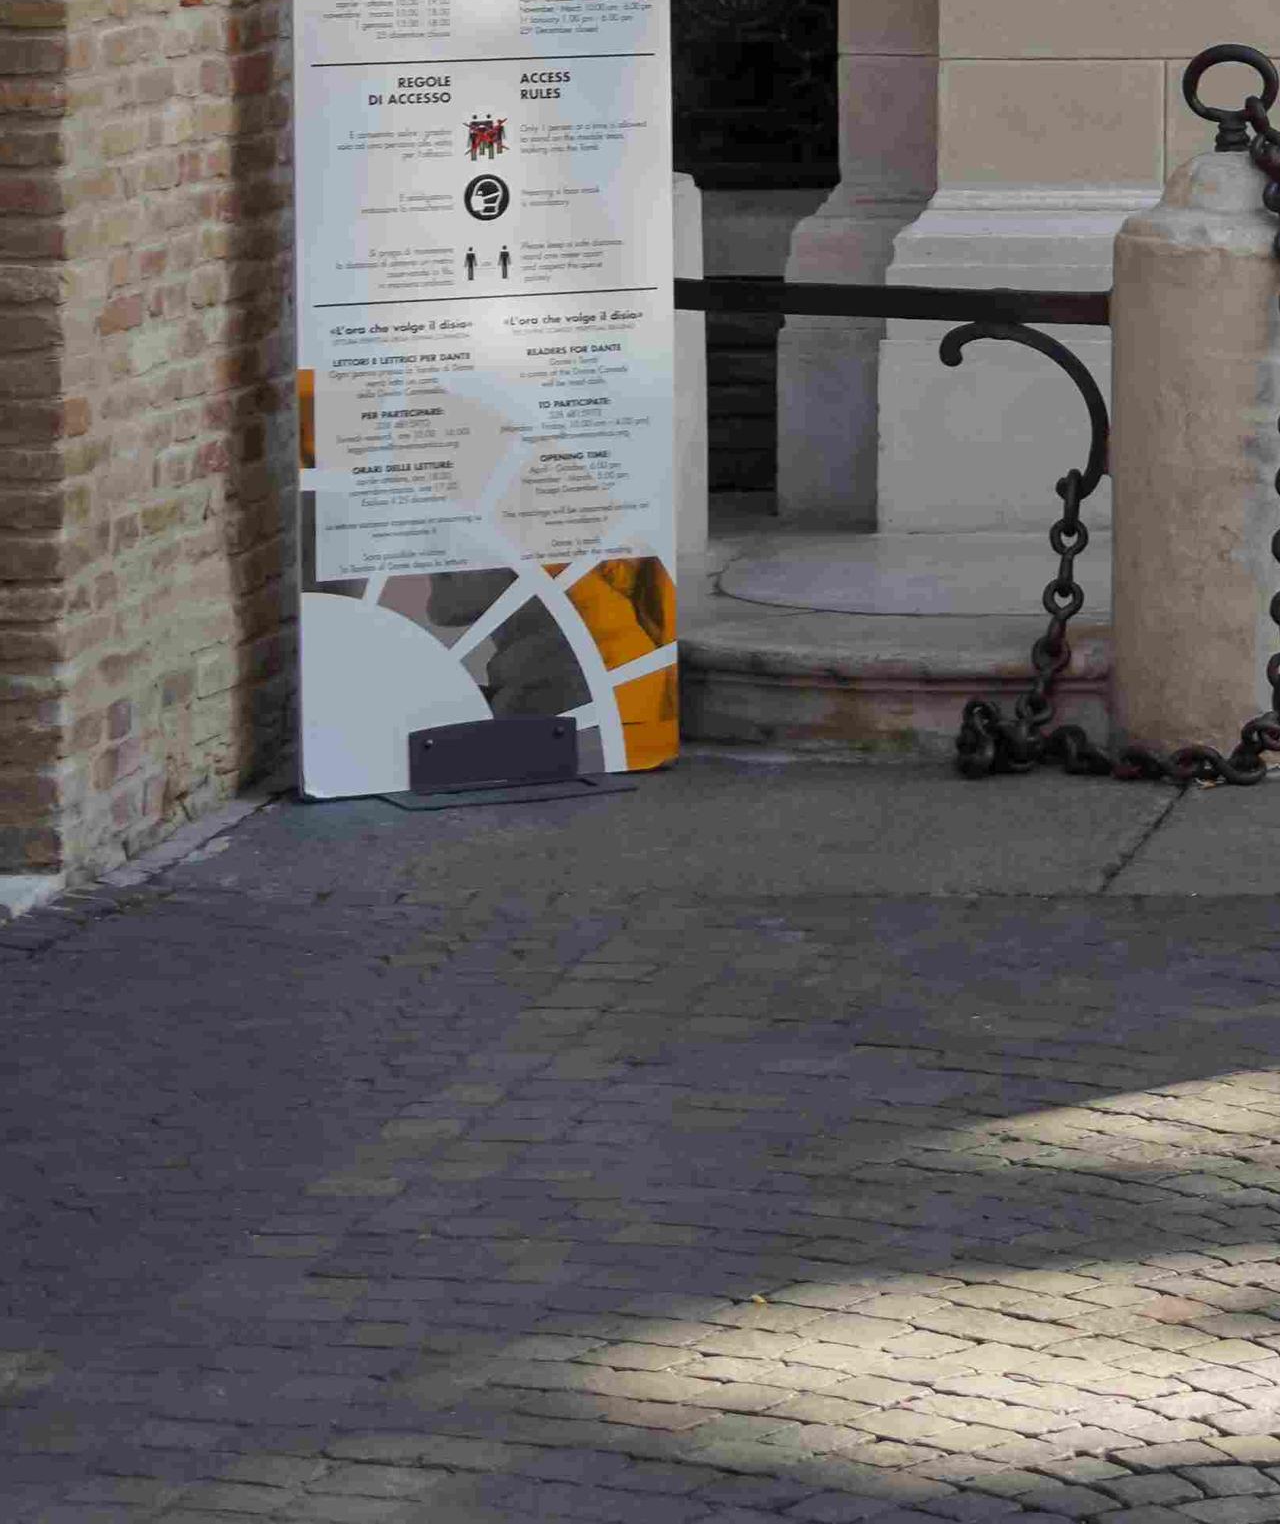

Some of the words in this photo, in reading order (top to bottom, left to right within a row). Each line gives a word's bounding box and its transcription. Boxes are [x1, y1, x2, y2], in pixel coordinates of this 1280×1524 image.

[398, 76, 451, 88] REGOLE
[520, 72, 571, 84] ACCESS
[369, 94, 383, 106] DI
[388, 93, 452, 105] ACCESSO
[520, 88, 561, 100] RULES
[543, 314, 563, 324] che
[600, 311, 607, 320] il
[369, 322, 390, 333] che
[429, 320, 436, 330] il
[527, 346, 568, 356] READERS
[570, 345, 588, 354] FOR
[591, 343, 622, 353] DANTE
[420, 354, 437, 363] PER
[440, 352, 471, 362] DANTE
[361, 410, 379, 420] PER
[353, 466, 383, 475] ORARI
